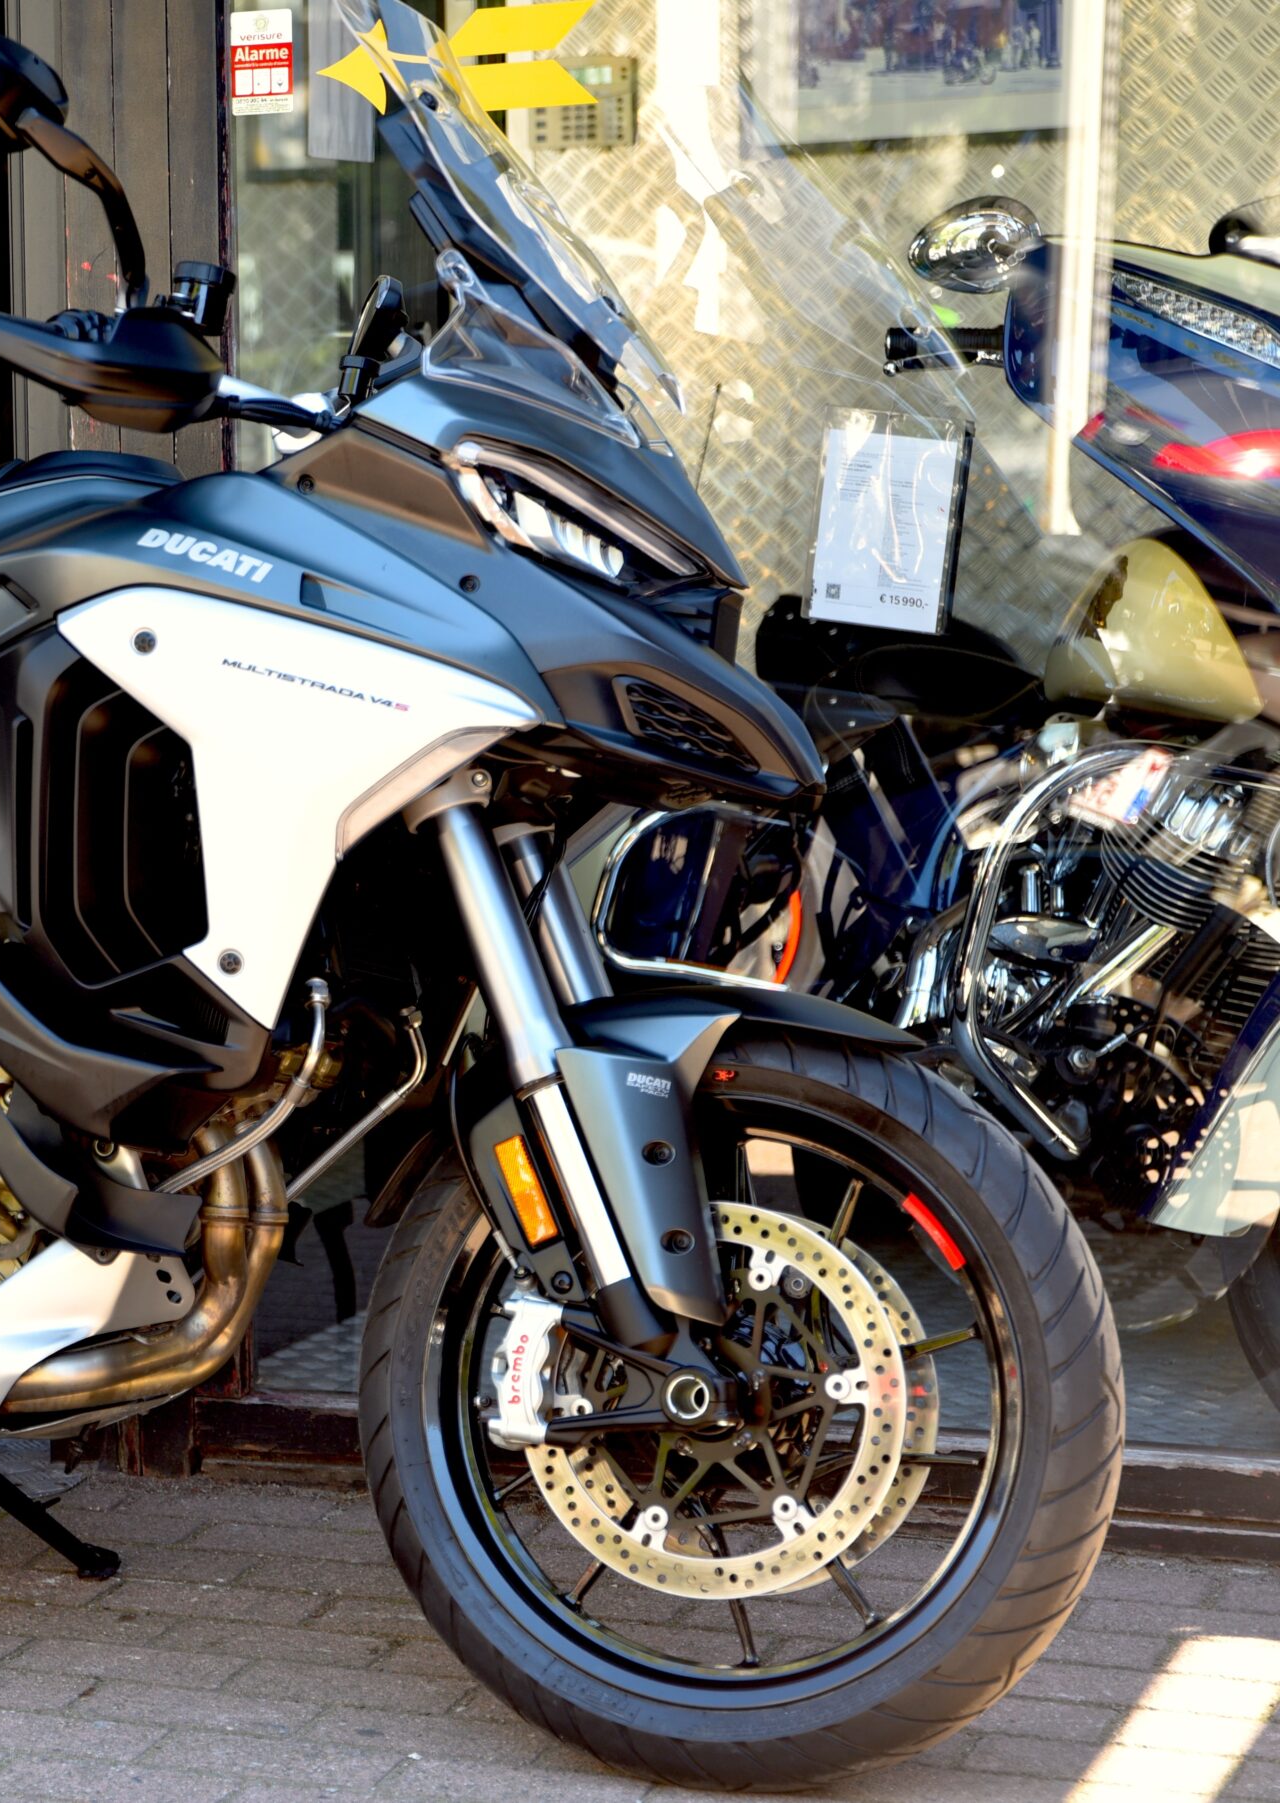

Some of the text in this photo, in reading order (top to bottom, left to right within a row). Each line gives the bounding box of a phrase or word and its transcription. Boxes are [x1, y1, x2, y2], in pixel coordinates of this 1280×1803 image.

[239, 32, 283, 41] verisure
[234, 47, 289, 62] Alarme
[137, 528, 273, 583] DUCATI
[879, 593, 887, 603] €
[222, 658, 411, 712] MULTISTRADA V4S
[626, 1072, 672, 1090] DUCATI
[507, 1334, 529, 1405] brembo
